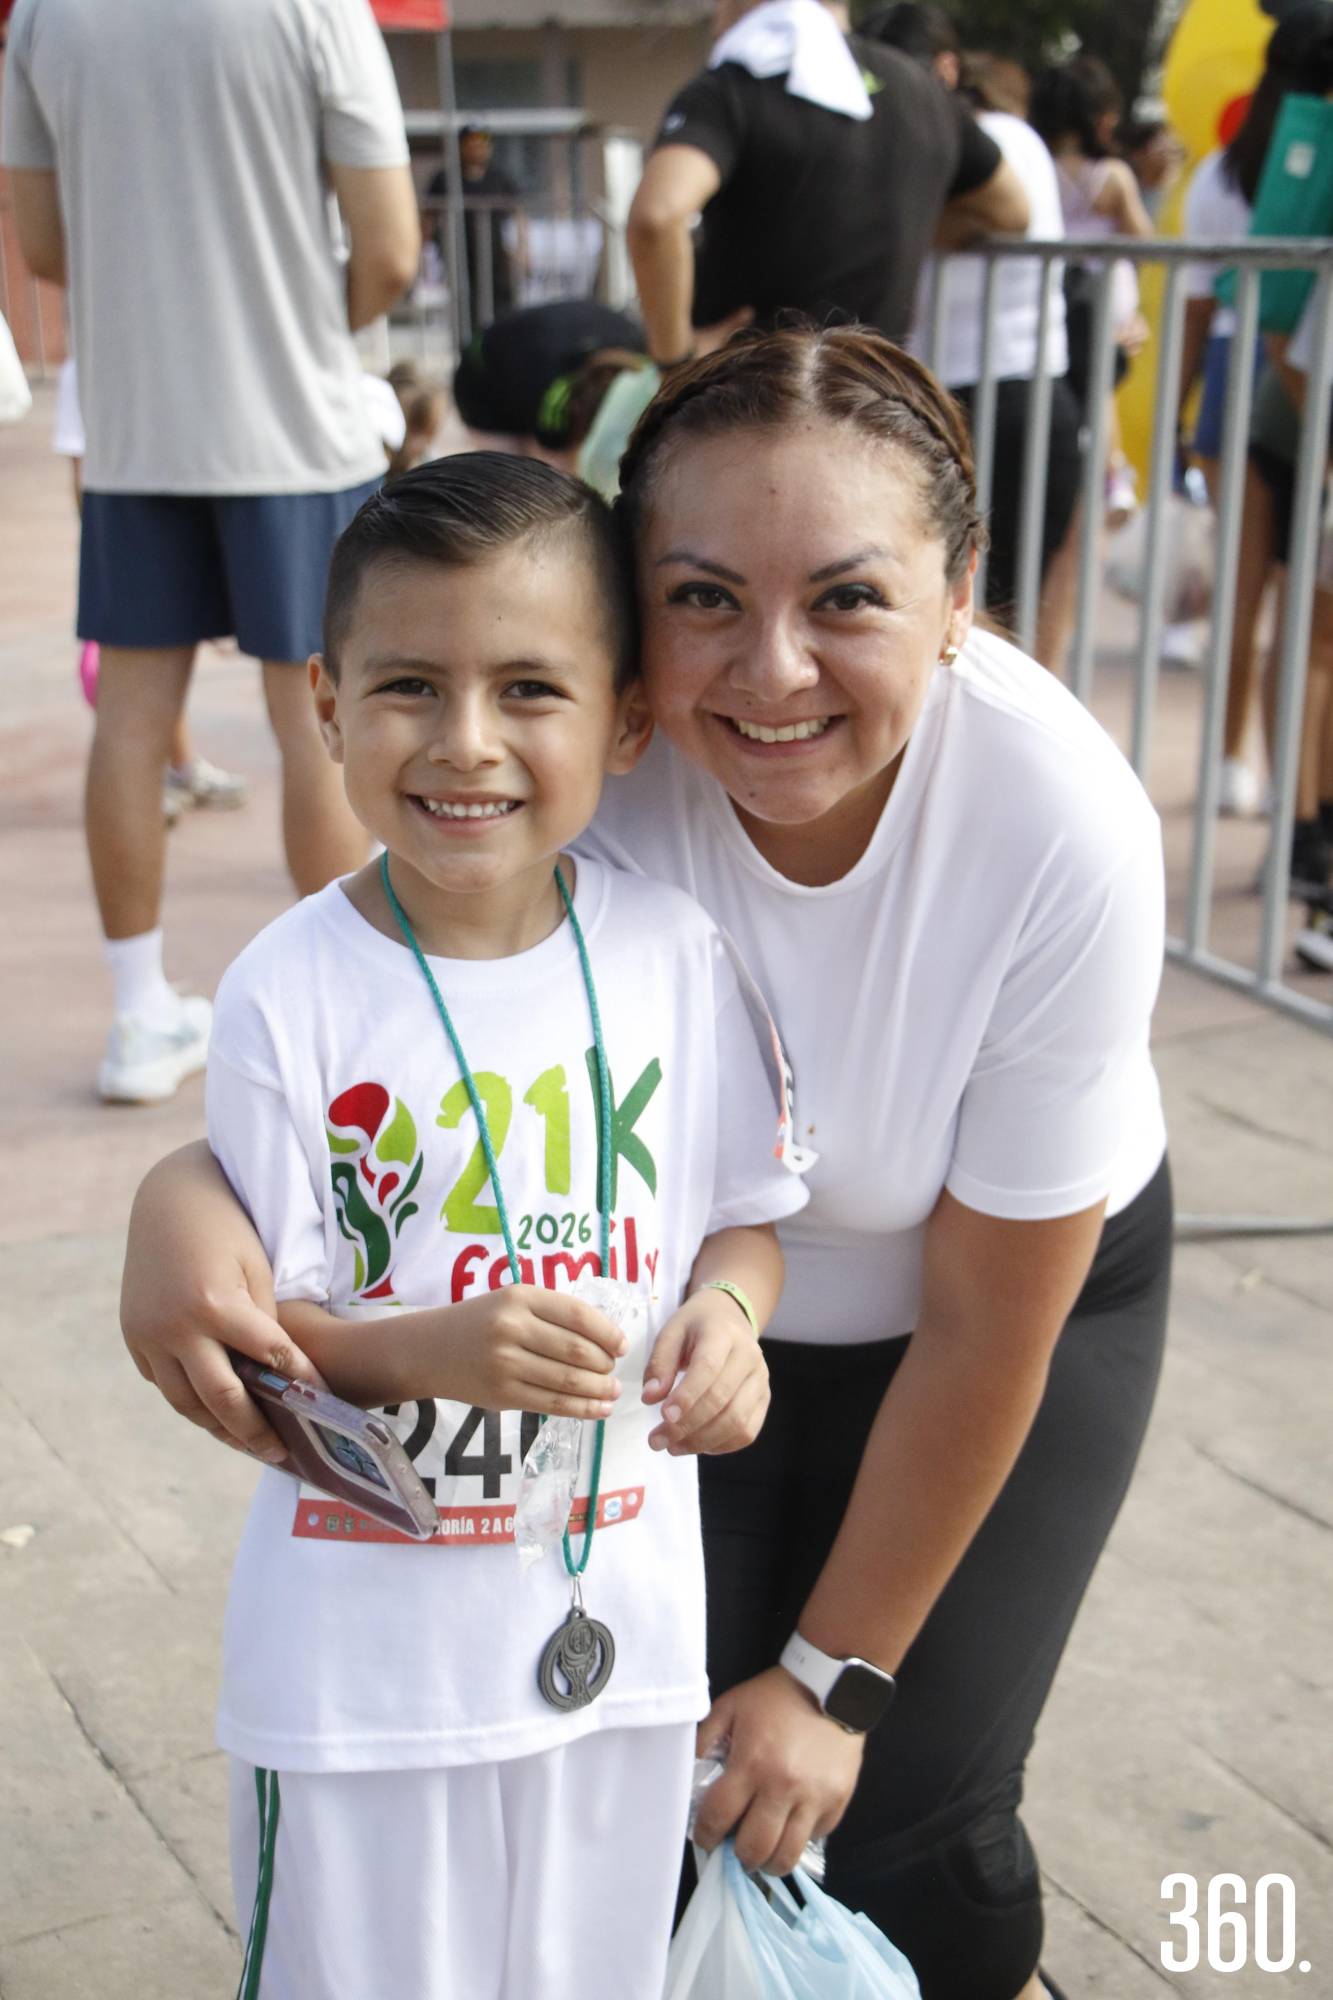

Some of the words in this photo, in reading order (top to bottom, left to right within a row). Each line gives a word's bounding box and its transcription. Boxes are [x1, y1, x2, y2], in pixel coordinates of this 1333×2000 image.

[436, 1045, 662, 1234] 21K
[516, 1212, 592, 1250] 2026
[481, 1518, 490, 1535] 2
[493, 1517, 503, 1534] A
